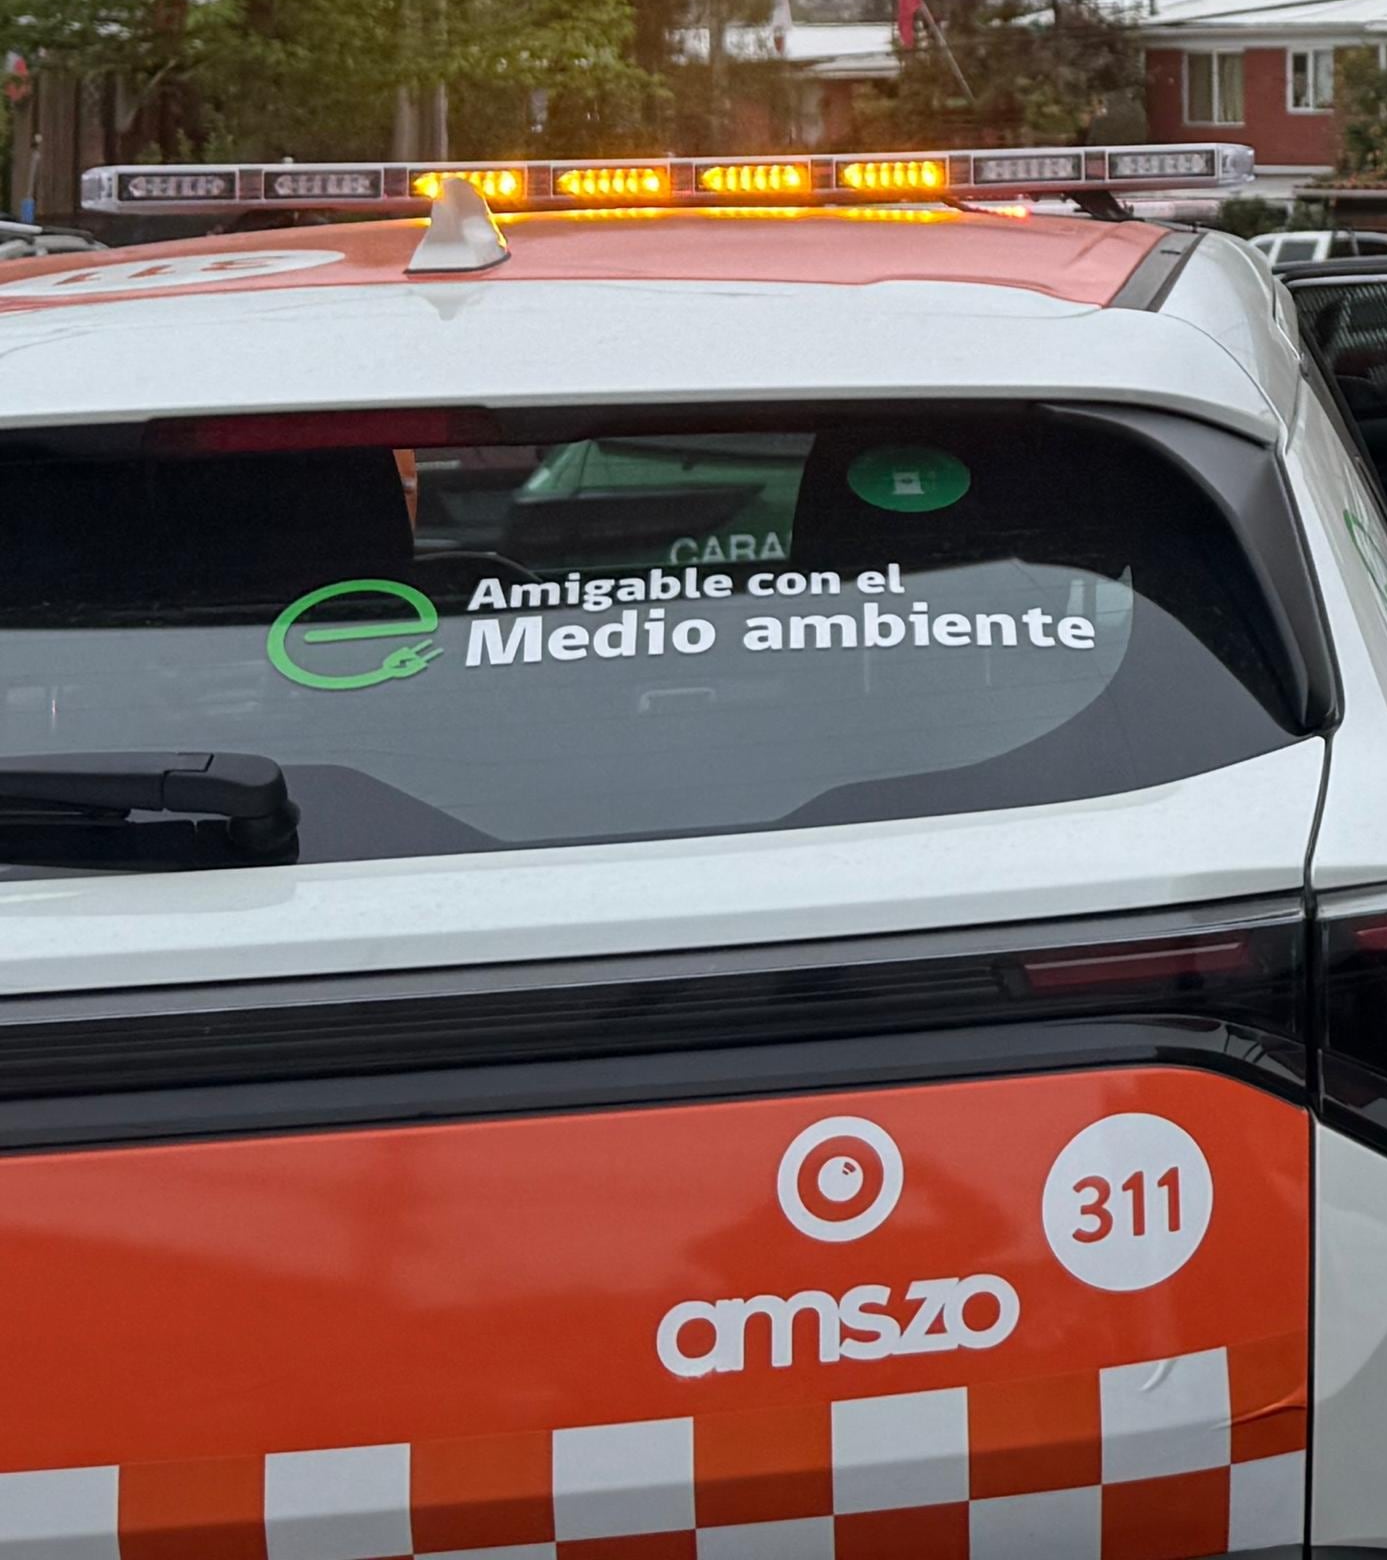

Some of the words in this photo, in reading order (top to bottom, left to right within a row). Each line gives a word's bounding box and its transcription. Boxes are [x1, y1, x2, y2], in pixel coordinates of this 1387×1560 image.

[467, 568, 734, 613] Amigable
[746, 569, 842, 597] con
[856, 563, 906, 595] el
[465, 608, 717, 668] Medio
[742, 601, 1097, 651] ambiente
[1071, 1165, 1182, 1244] 311
[656, 1273, 1021, 1378] amszo
